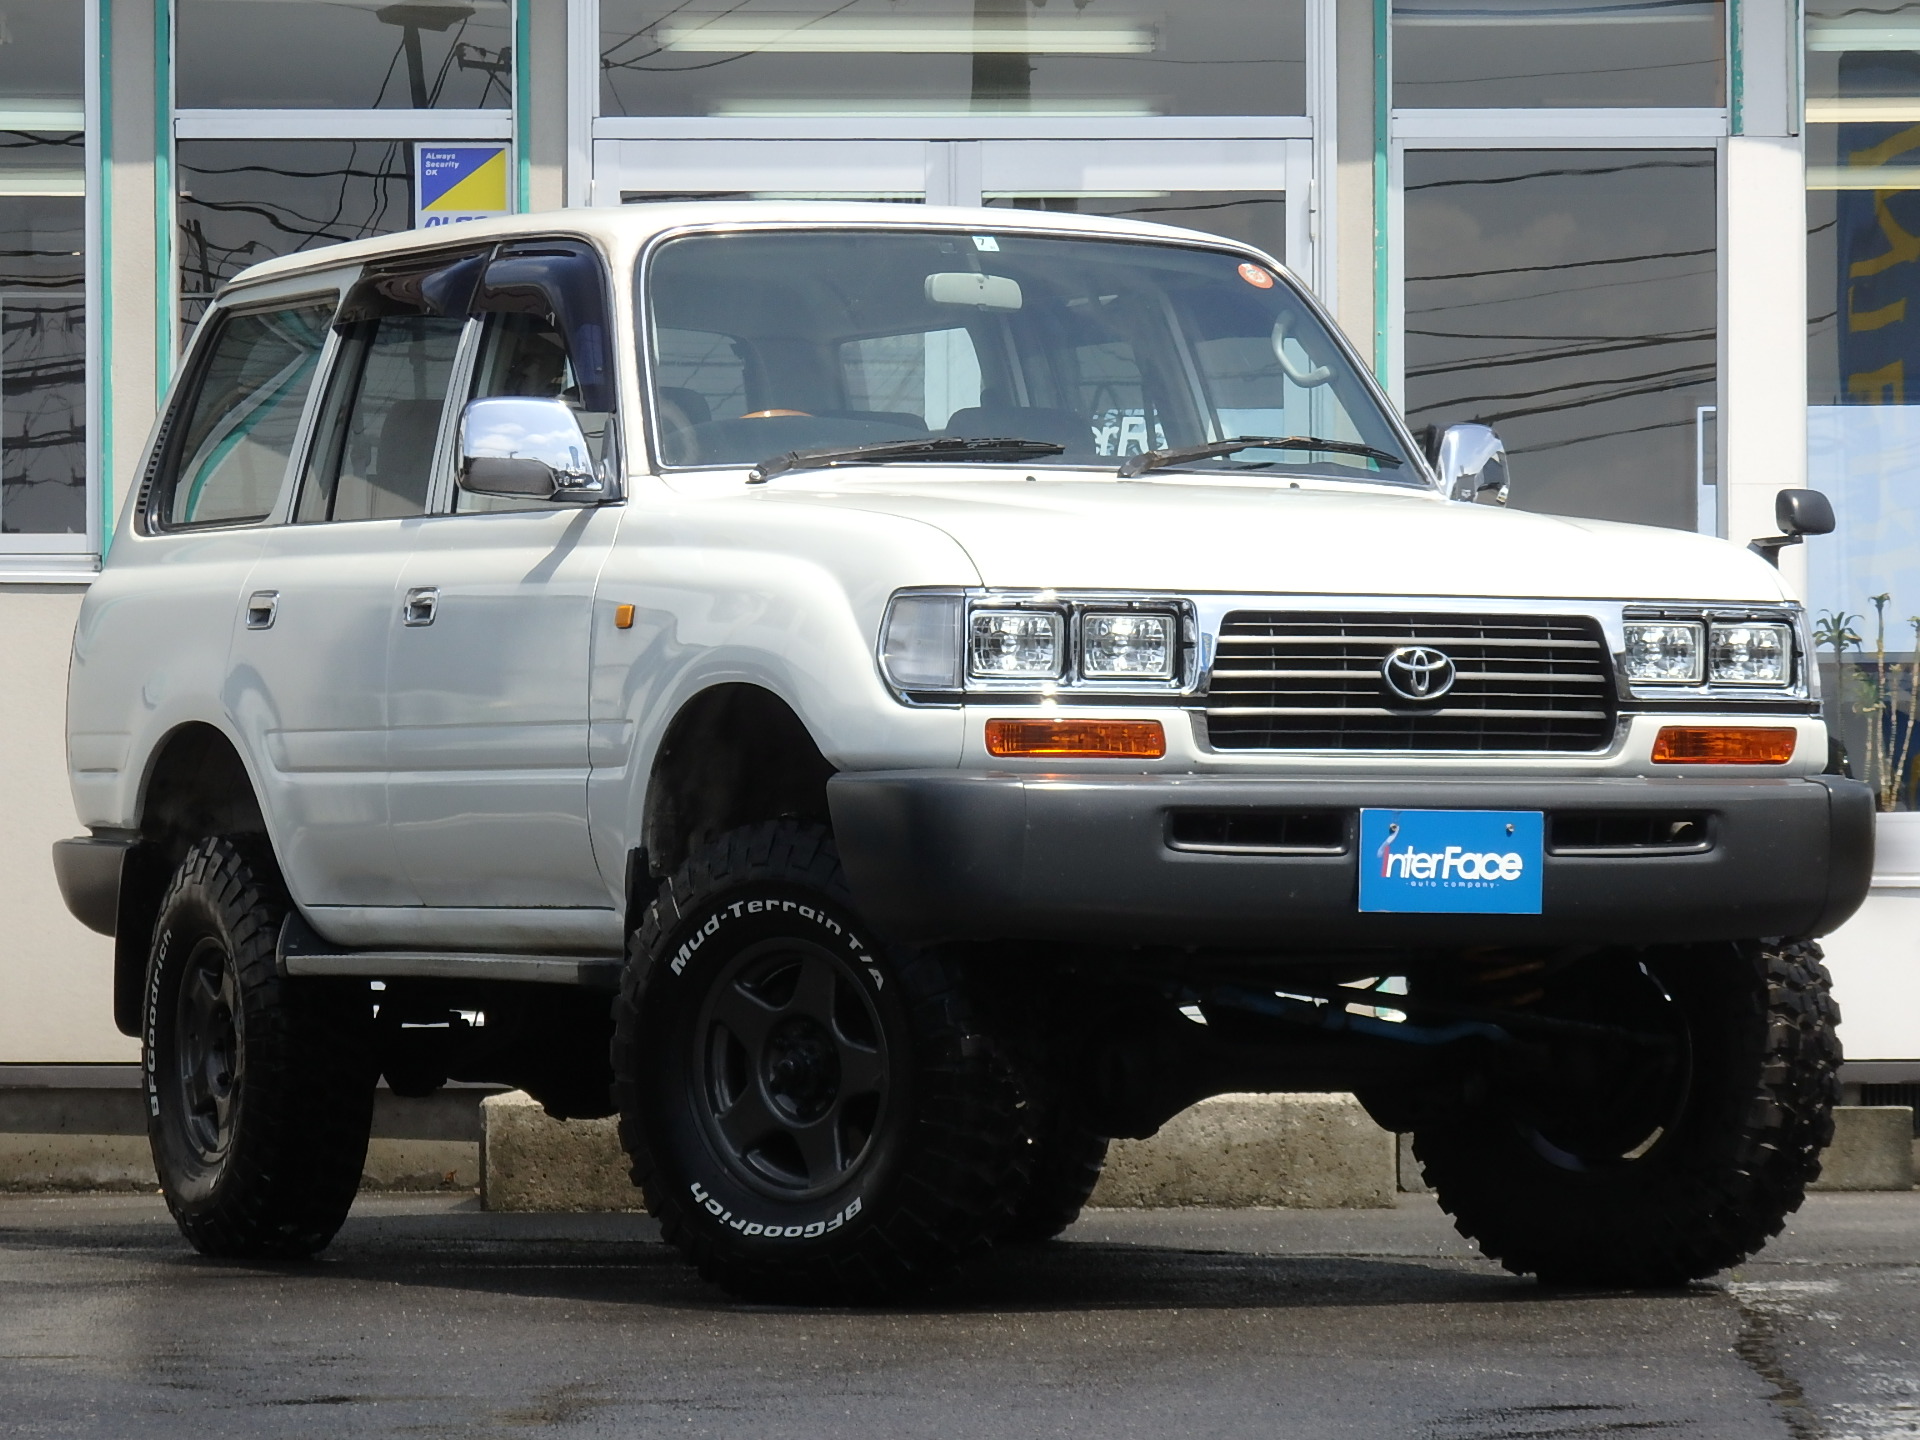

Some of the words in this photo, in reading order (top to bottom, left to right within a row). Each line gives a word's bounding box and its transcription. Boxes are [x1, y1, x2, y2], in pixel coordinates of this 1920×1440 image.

[425, 161, 460, 169] Security
[671, 899, 842, 976] Mud-Terrain
[848, 932, 884, 991] T/A
[147, 928, 172, 1117] BFGoodrich
[690, 1182, 862, 1238] BFGoodrich
